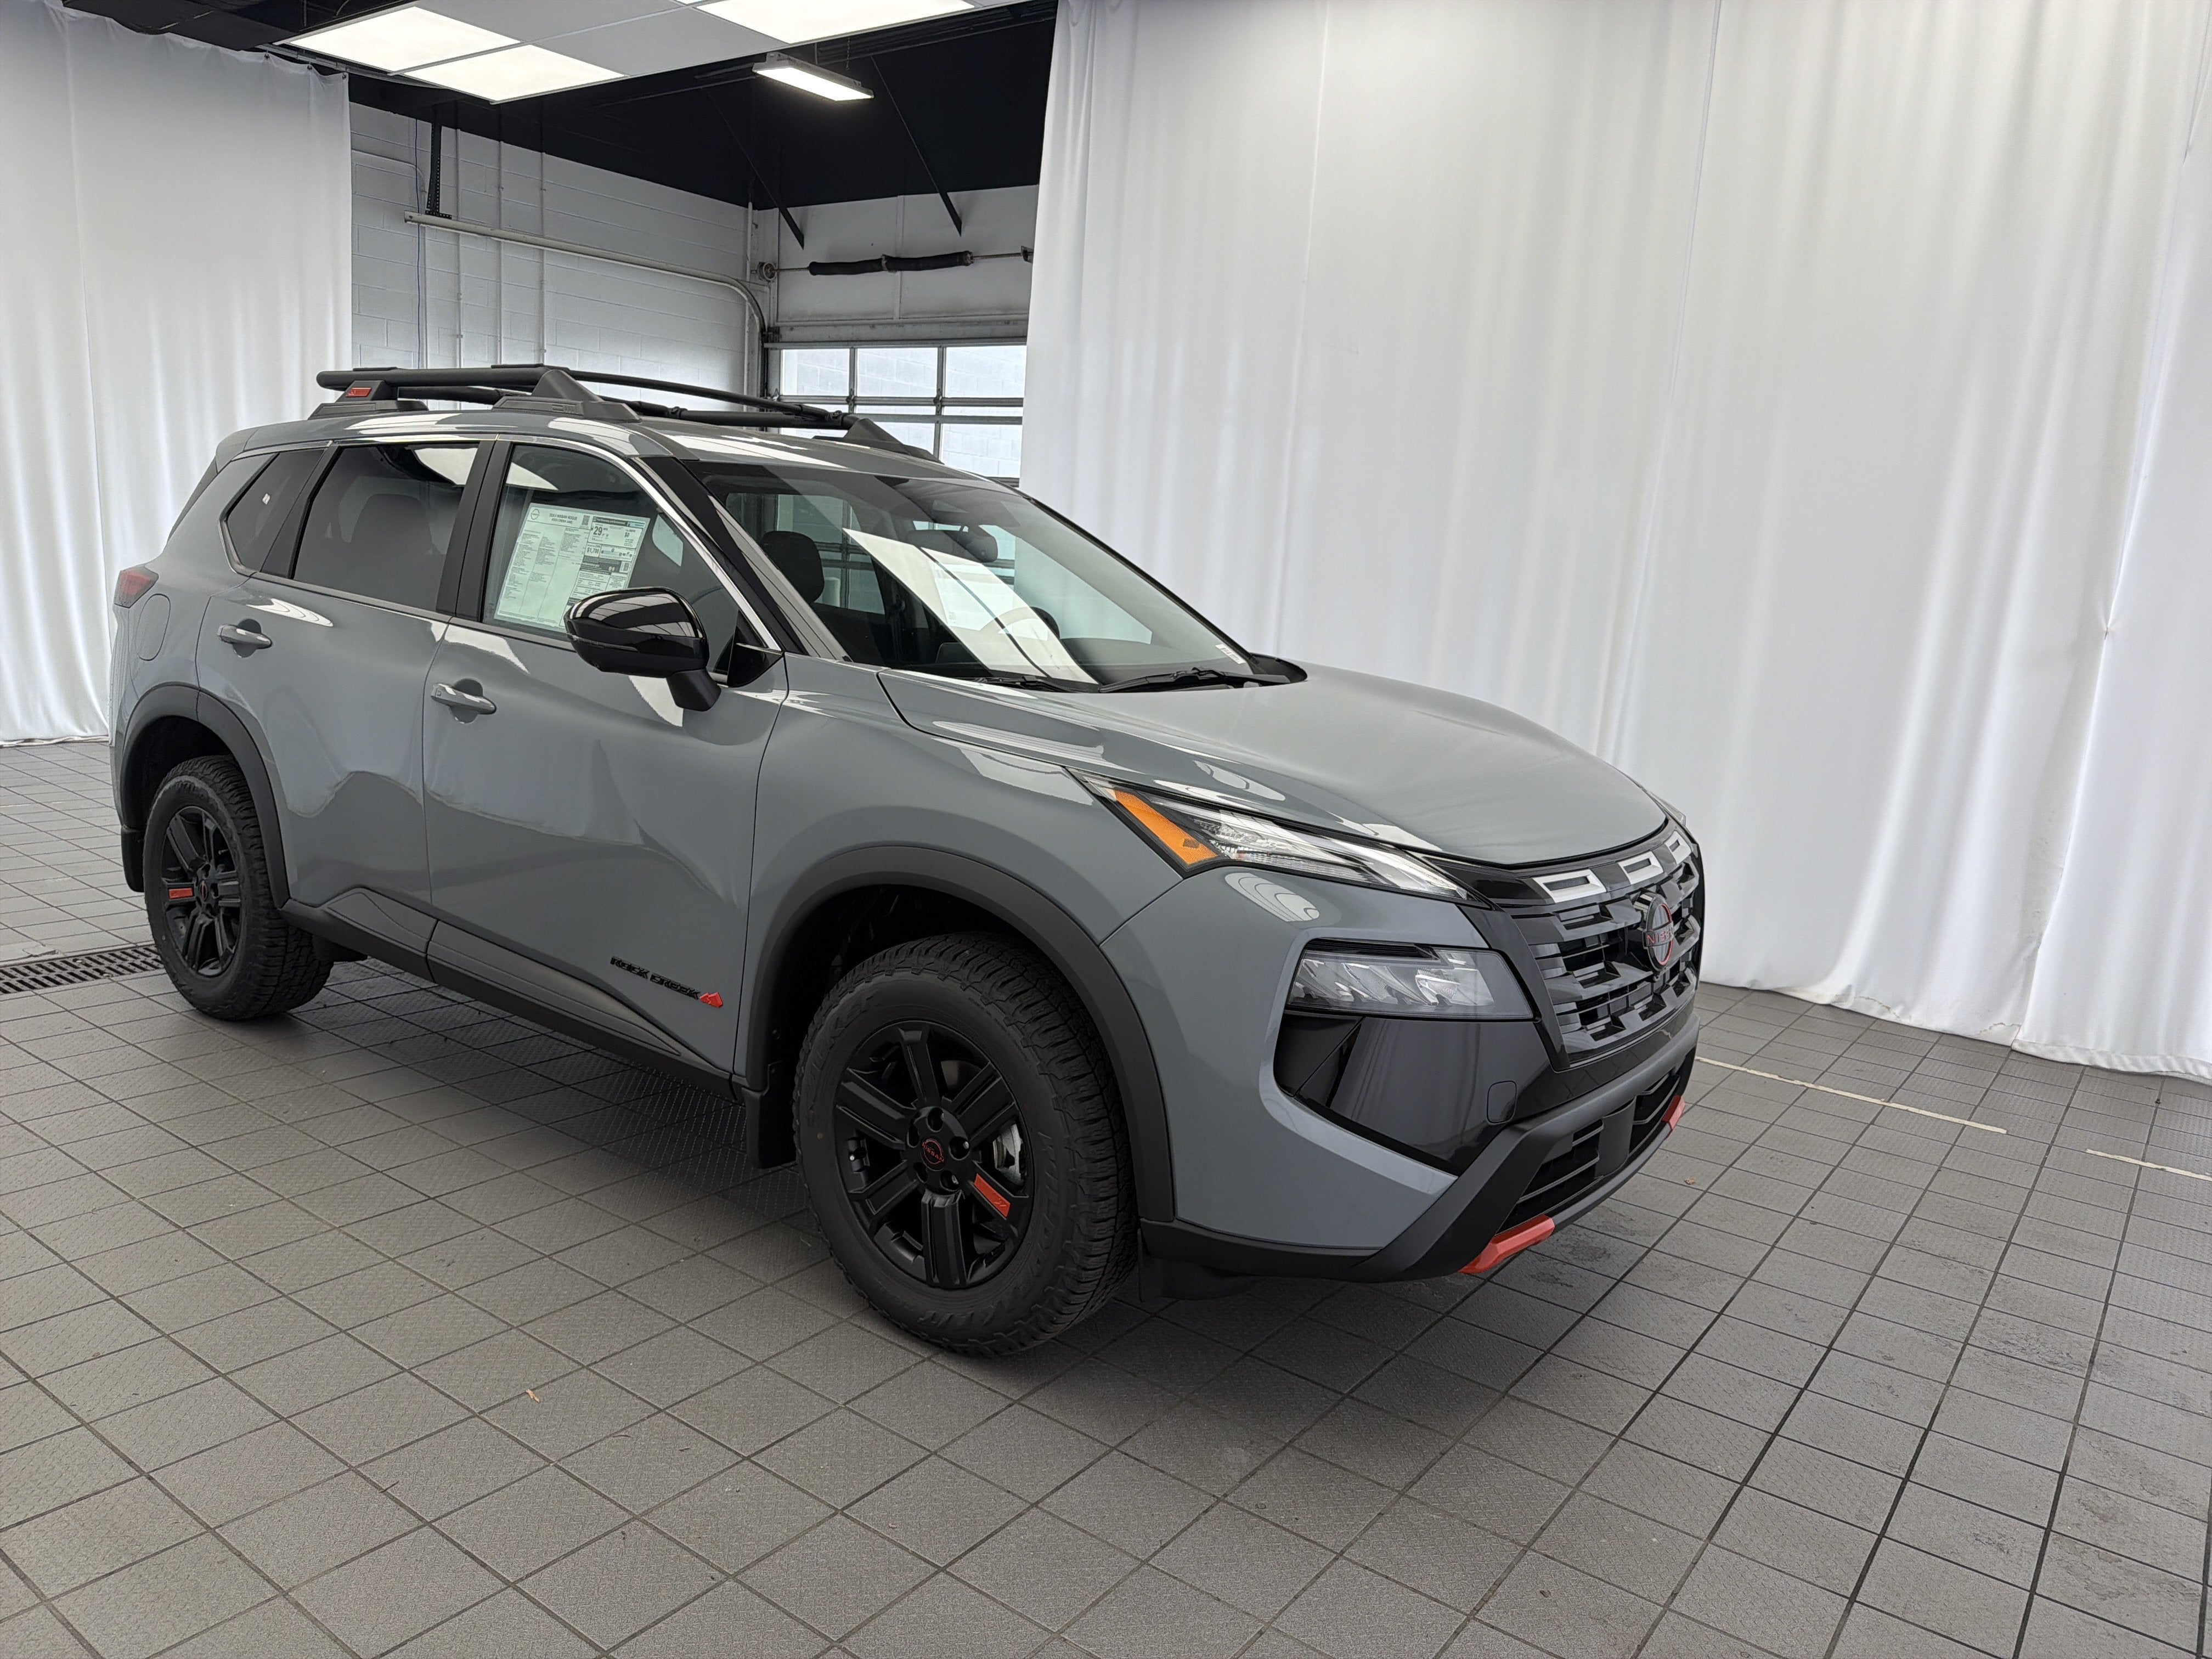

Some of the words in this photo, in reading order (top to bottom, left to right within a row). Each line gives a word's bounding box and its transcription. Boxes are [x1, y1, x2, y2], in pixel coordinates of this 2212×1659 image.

[593, 526, 602, 535] 29
[610, 956, 650, 979] ROCK
[650, 973, 700, 1000] CREEK
